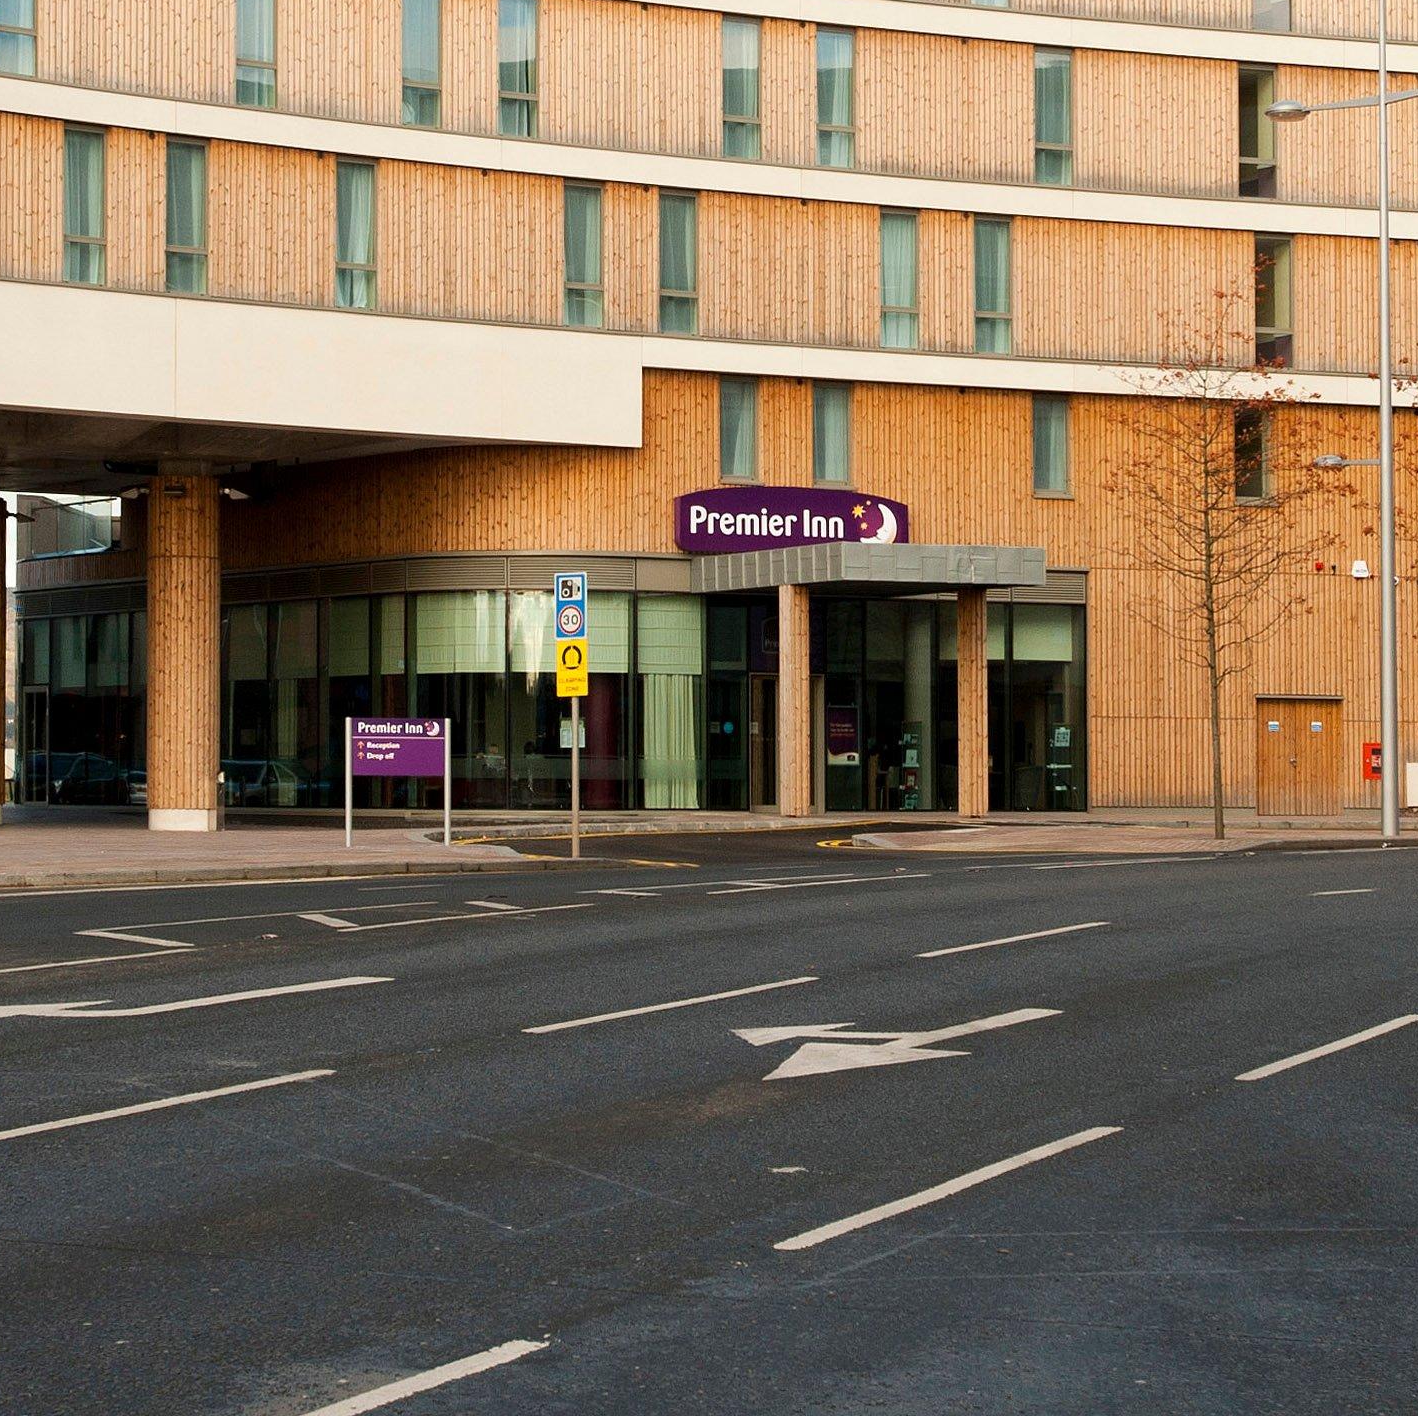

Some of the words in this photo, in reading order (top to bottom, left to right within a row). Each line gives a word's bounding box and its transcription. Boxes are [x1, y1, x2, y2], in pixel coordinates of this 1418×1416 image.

[690, 505, 798, 537] Premier
[803, 509, 845, 539] Inn
[563, 615, 578, 625] 30
[357, 722, 402, 733] Premier
[405, 722, 423, 733] Inn
[367, 742, 400, 750] Reception
